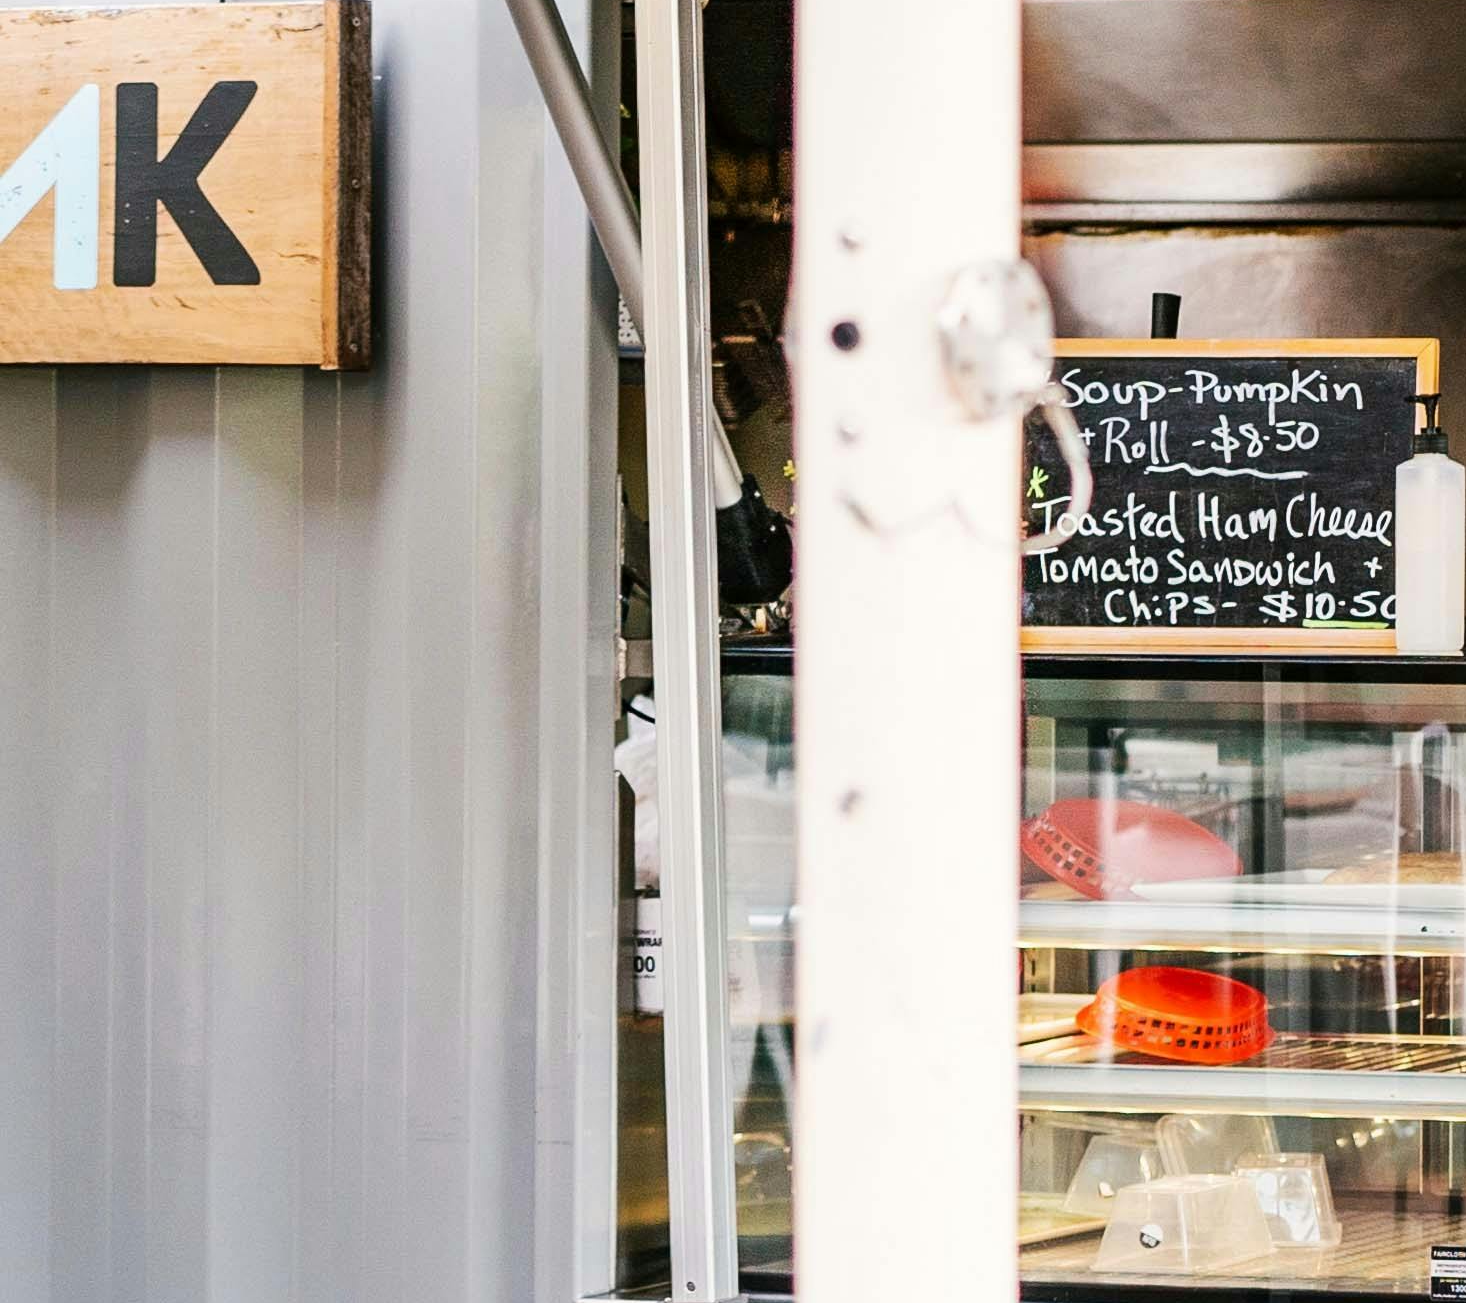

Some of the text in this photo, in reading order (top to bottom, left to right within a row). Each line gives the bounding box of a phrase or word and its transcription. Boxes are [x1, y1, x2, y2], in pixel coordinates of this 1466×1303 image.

[1100, 416, 1170, 464] Roll
[1198, 493, 1277, 542] Ham
[1286, 492, 1393, 547] Cheese
[1025, 546, 1160, 585] Tomato
